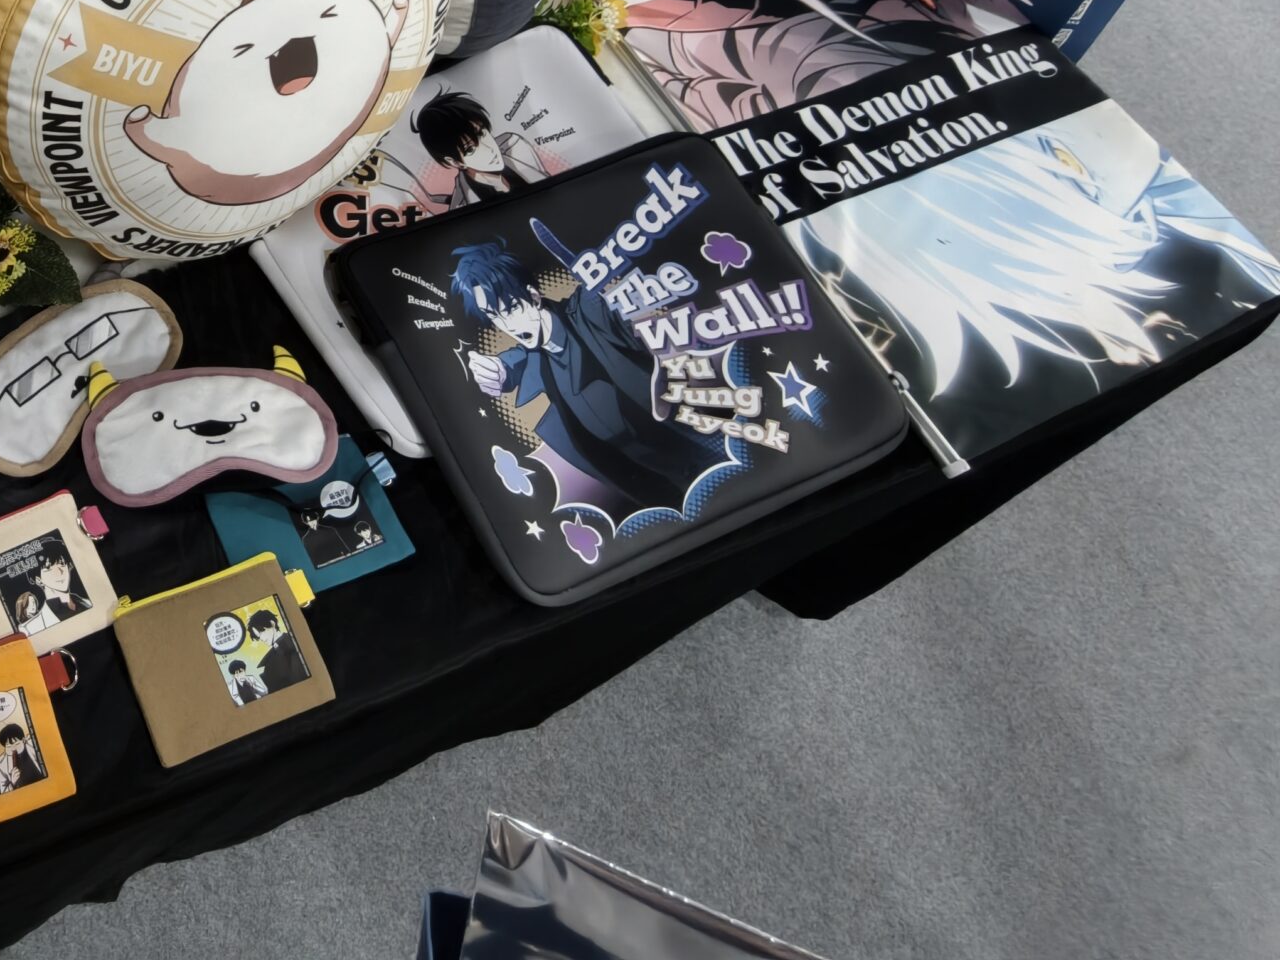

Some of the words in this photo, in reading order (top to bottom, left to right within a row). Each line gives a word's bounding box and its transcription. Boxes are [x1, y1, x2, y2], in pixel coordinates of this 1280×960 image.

[92, 43, 164, 87] BIYU
[375, 87, 411, 116] BIYU
[521, 107, 550, 131] Reader's
[712, 127, 804, 177] The
[795, 73, 959, 147] Demon
[948, 42, 1059, 94] King
[534, 126, 576, 147] Viewpoint
[798, 109, 1010, 202] Salvation.
[41, 91, 120, 228] VIEWPOINT
[320, 193, 423, 239] Get
[570, 162, 704, 293] Break
[391, 267, 448, 300] Omniscient
[606, 263, 696, 316] The
[407, 294, 446, 315] Reader's
[413, 317, 455, 332] Viewpoint
[661, 355, 716, 381] Yu
[661, 381, 763, 417] Jung
[675, 406, 791, 453] hyeok
